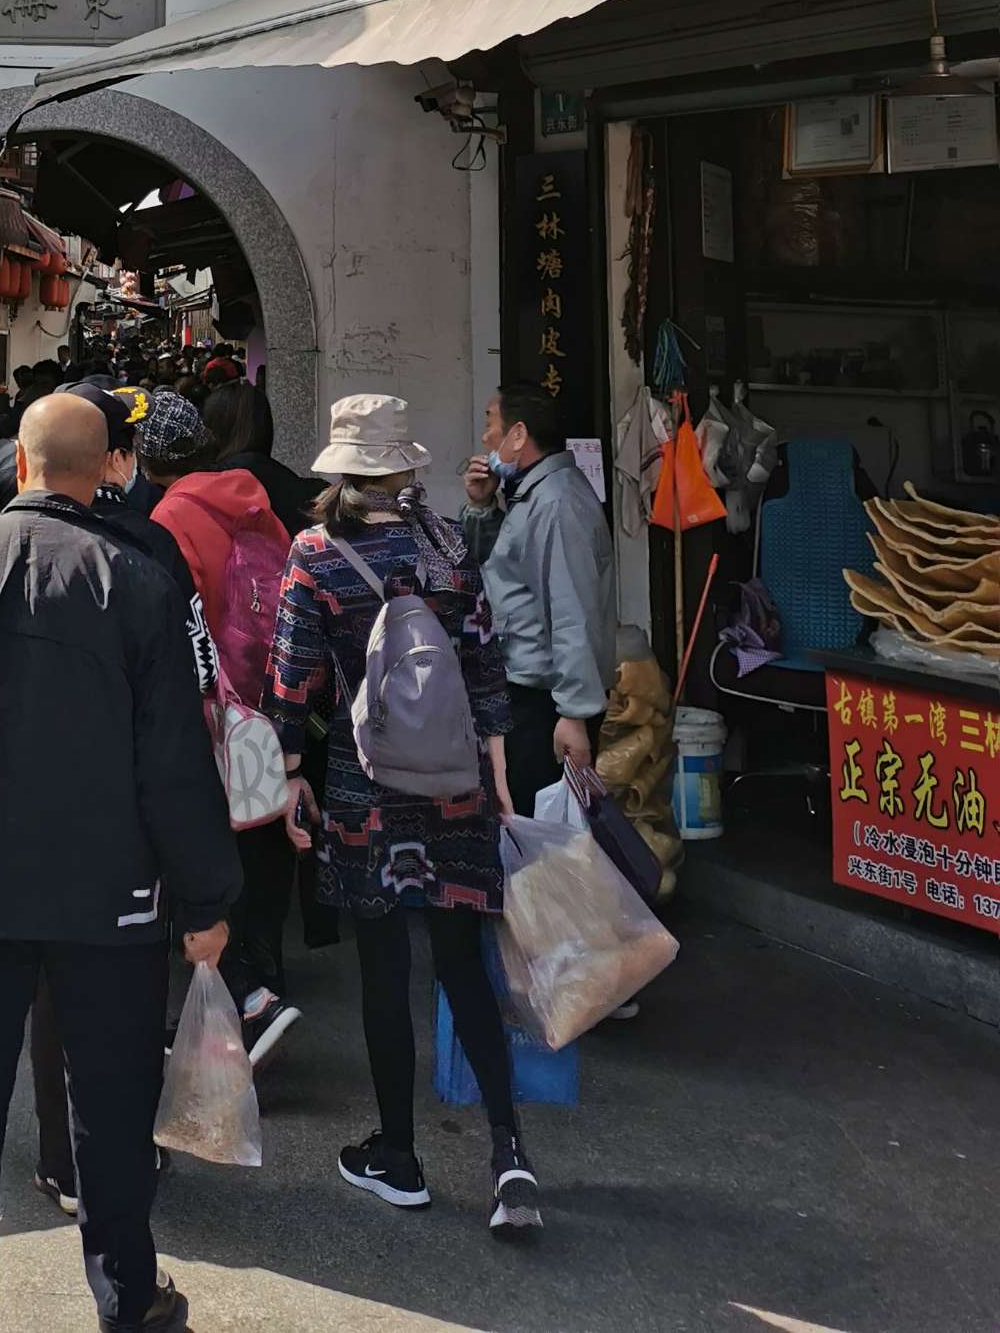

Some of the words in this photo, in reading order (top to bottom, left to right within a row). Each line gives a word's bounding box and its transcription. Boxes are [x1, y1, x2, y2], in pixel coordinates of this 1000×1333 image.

[839, 737, 1000, 837] 正宗无油
[848, 856, 918, 895] 兴东街1号
